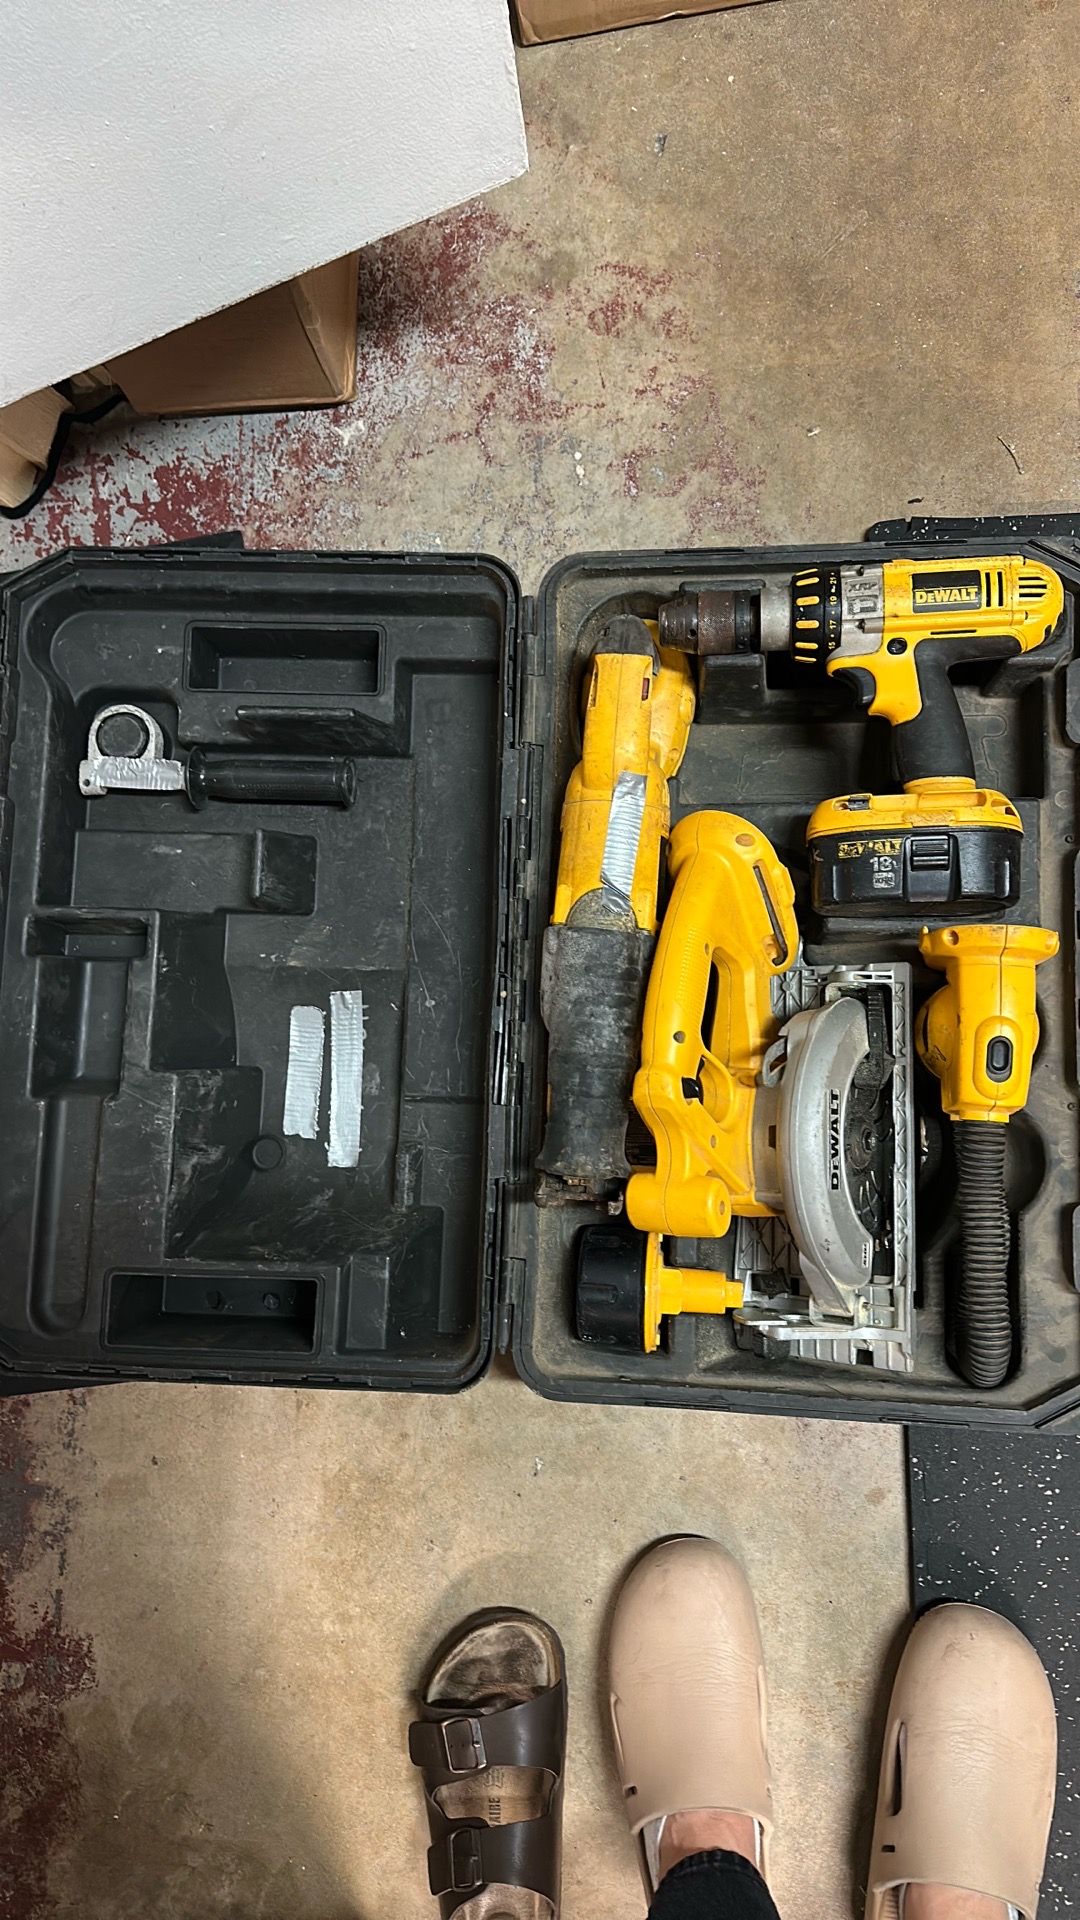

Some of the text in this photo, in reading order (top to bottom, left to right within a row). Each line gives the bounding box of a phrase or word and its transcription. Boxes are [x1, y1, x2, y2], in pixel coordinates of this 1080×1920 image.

[829, 596, 837, 606] 19
[915, 587, 979, 604] DEWALT
[829, 620, 837, 630] 17
[830, 1089, 840, 1190] DEWALT
